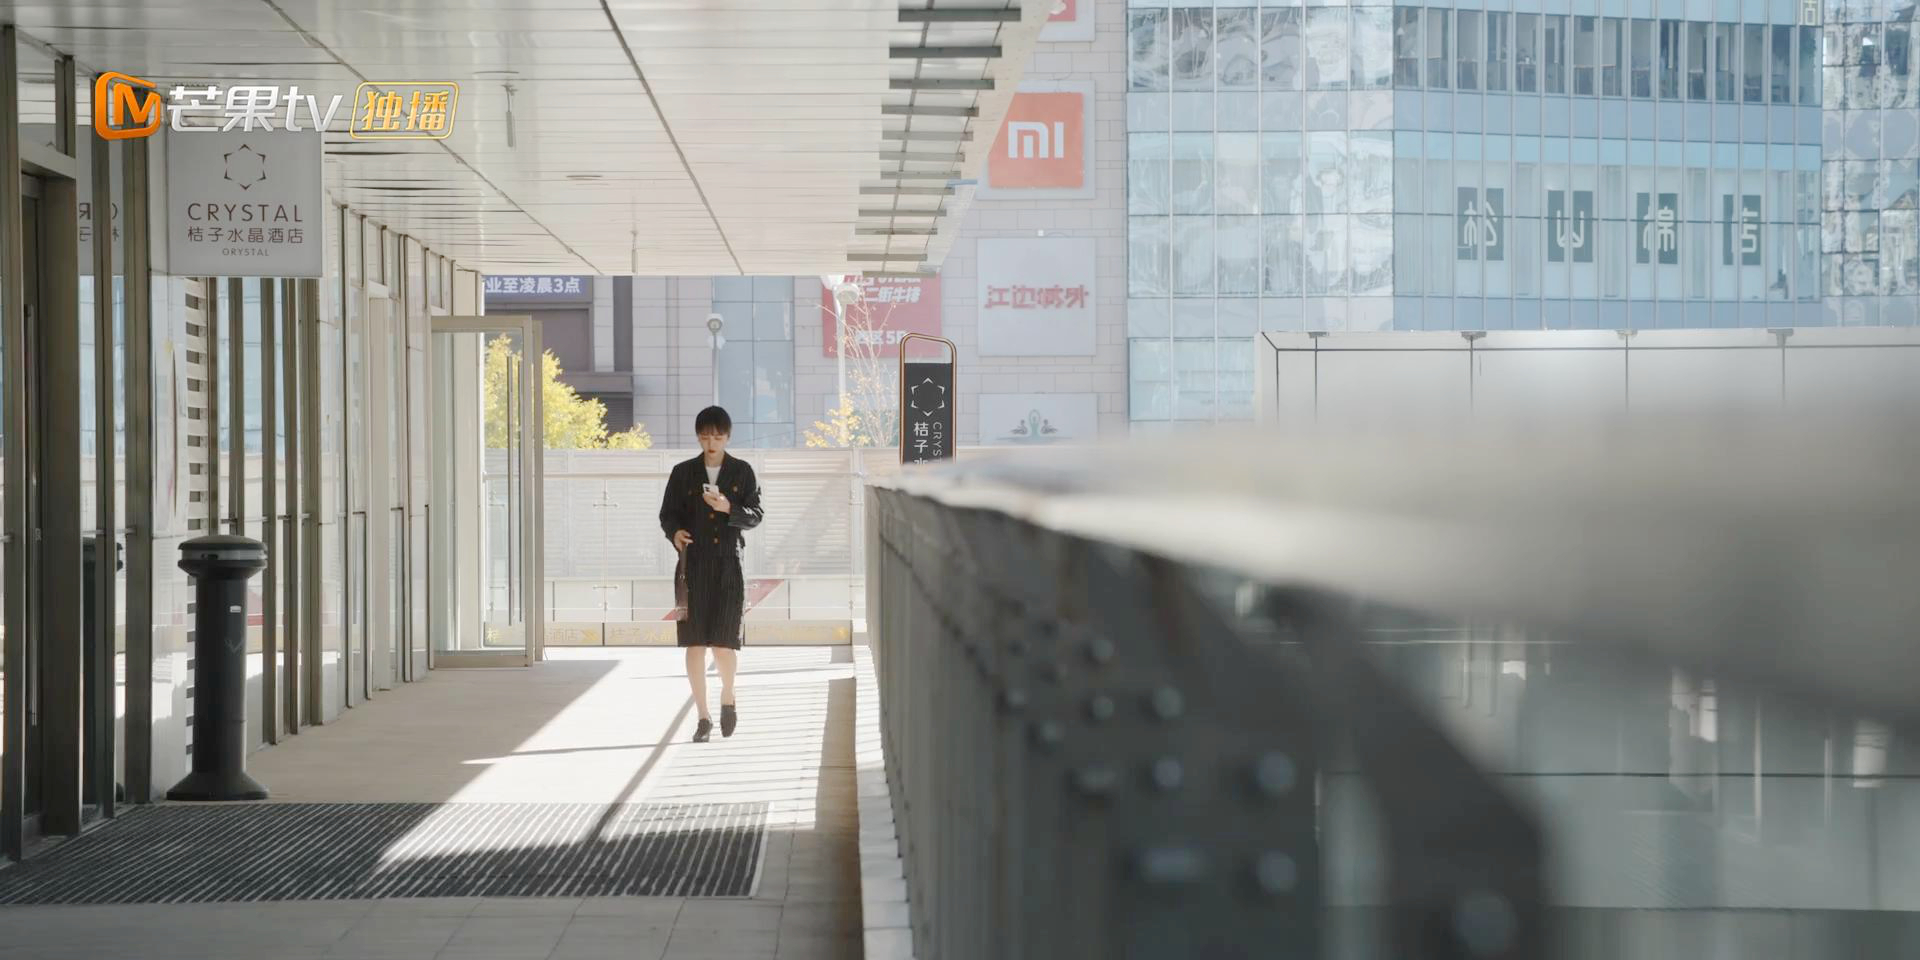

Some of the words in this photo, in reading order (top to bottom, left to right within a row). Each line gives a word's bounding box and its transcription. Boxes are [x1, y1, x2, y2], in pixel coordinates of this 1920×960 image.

[187, 202, 304, 223] CRYSTAL
[187, 226, 304, 244] 桔子水晶酒店
[485, 276, 581, 294] 业至凌晨3点
